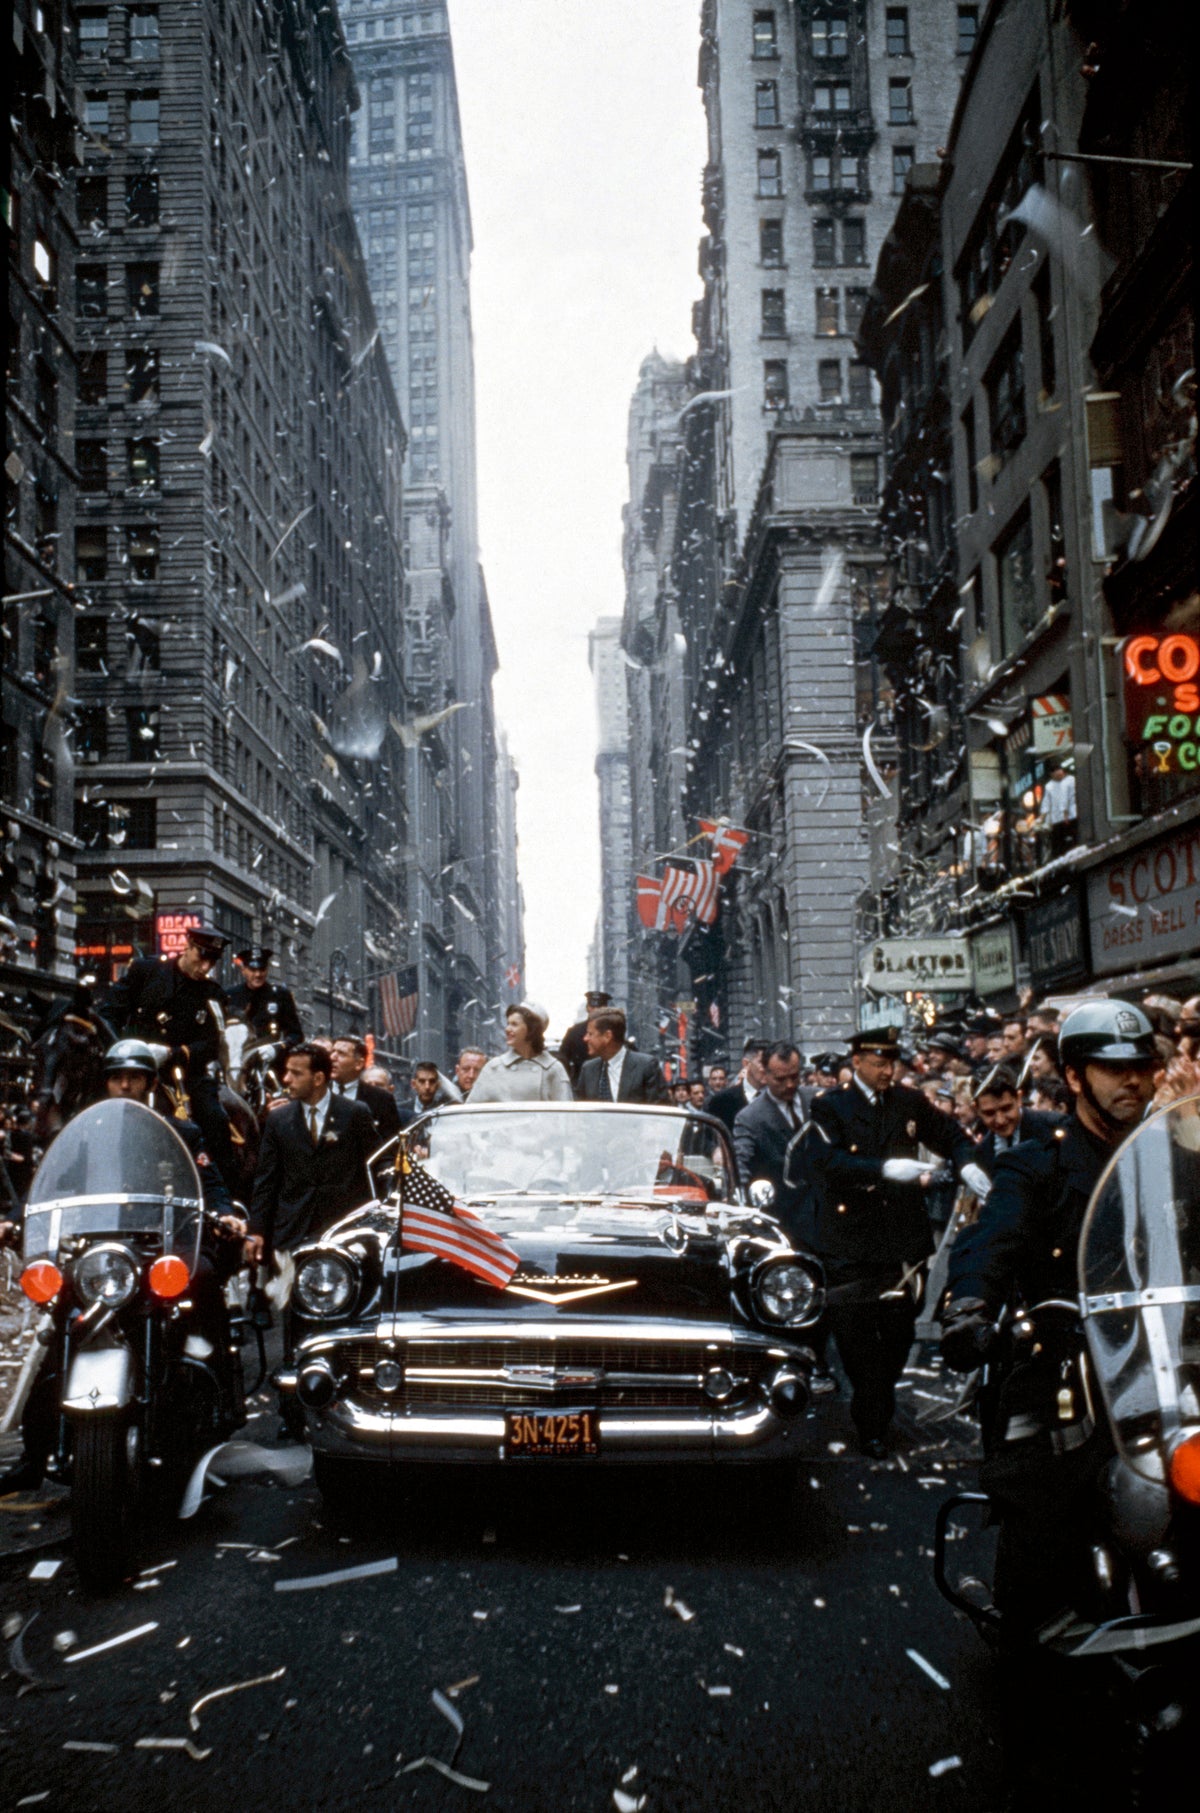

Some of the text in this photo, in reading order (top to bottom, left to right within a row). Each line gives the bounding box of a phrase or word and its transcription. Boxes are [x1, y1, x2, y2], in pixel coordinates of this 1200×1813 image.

[1142, 714, 1200, 739] FO
[1103, 918, 1143, 951] DRESS
[1149, 905, 1185, 937] WELL
